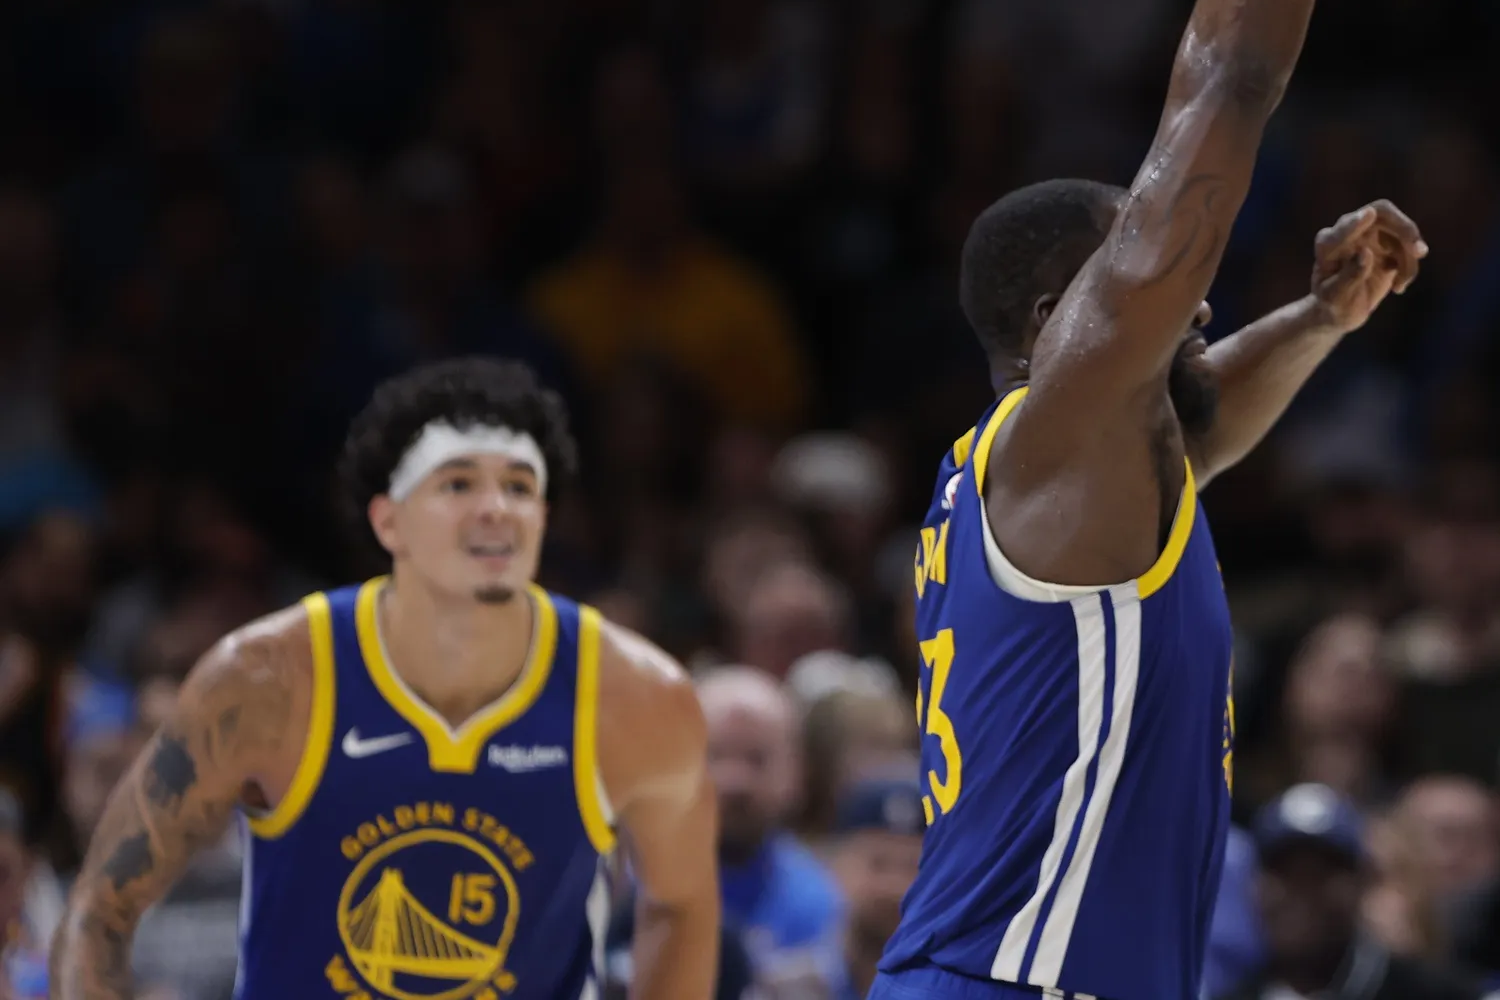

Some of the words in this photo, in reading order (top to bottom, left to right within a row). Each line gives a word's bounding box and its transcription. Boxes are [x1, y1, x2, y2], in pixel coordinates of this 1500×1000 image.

[916, 627, 963, 826] 3
[340, 802, 455, 860] GOLDEN
[461, 808, 536, 871] STATE
[448, 872, 497, 926] 15
